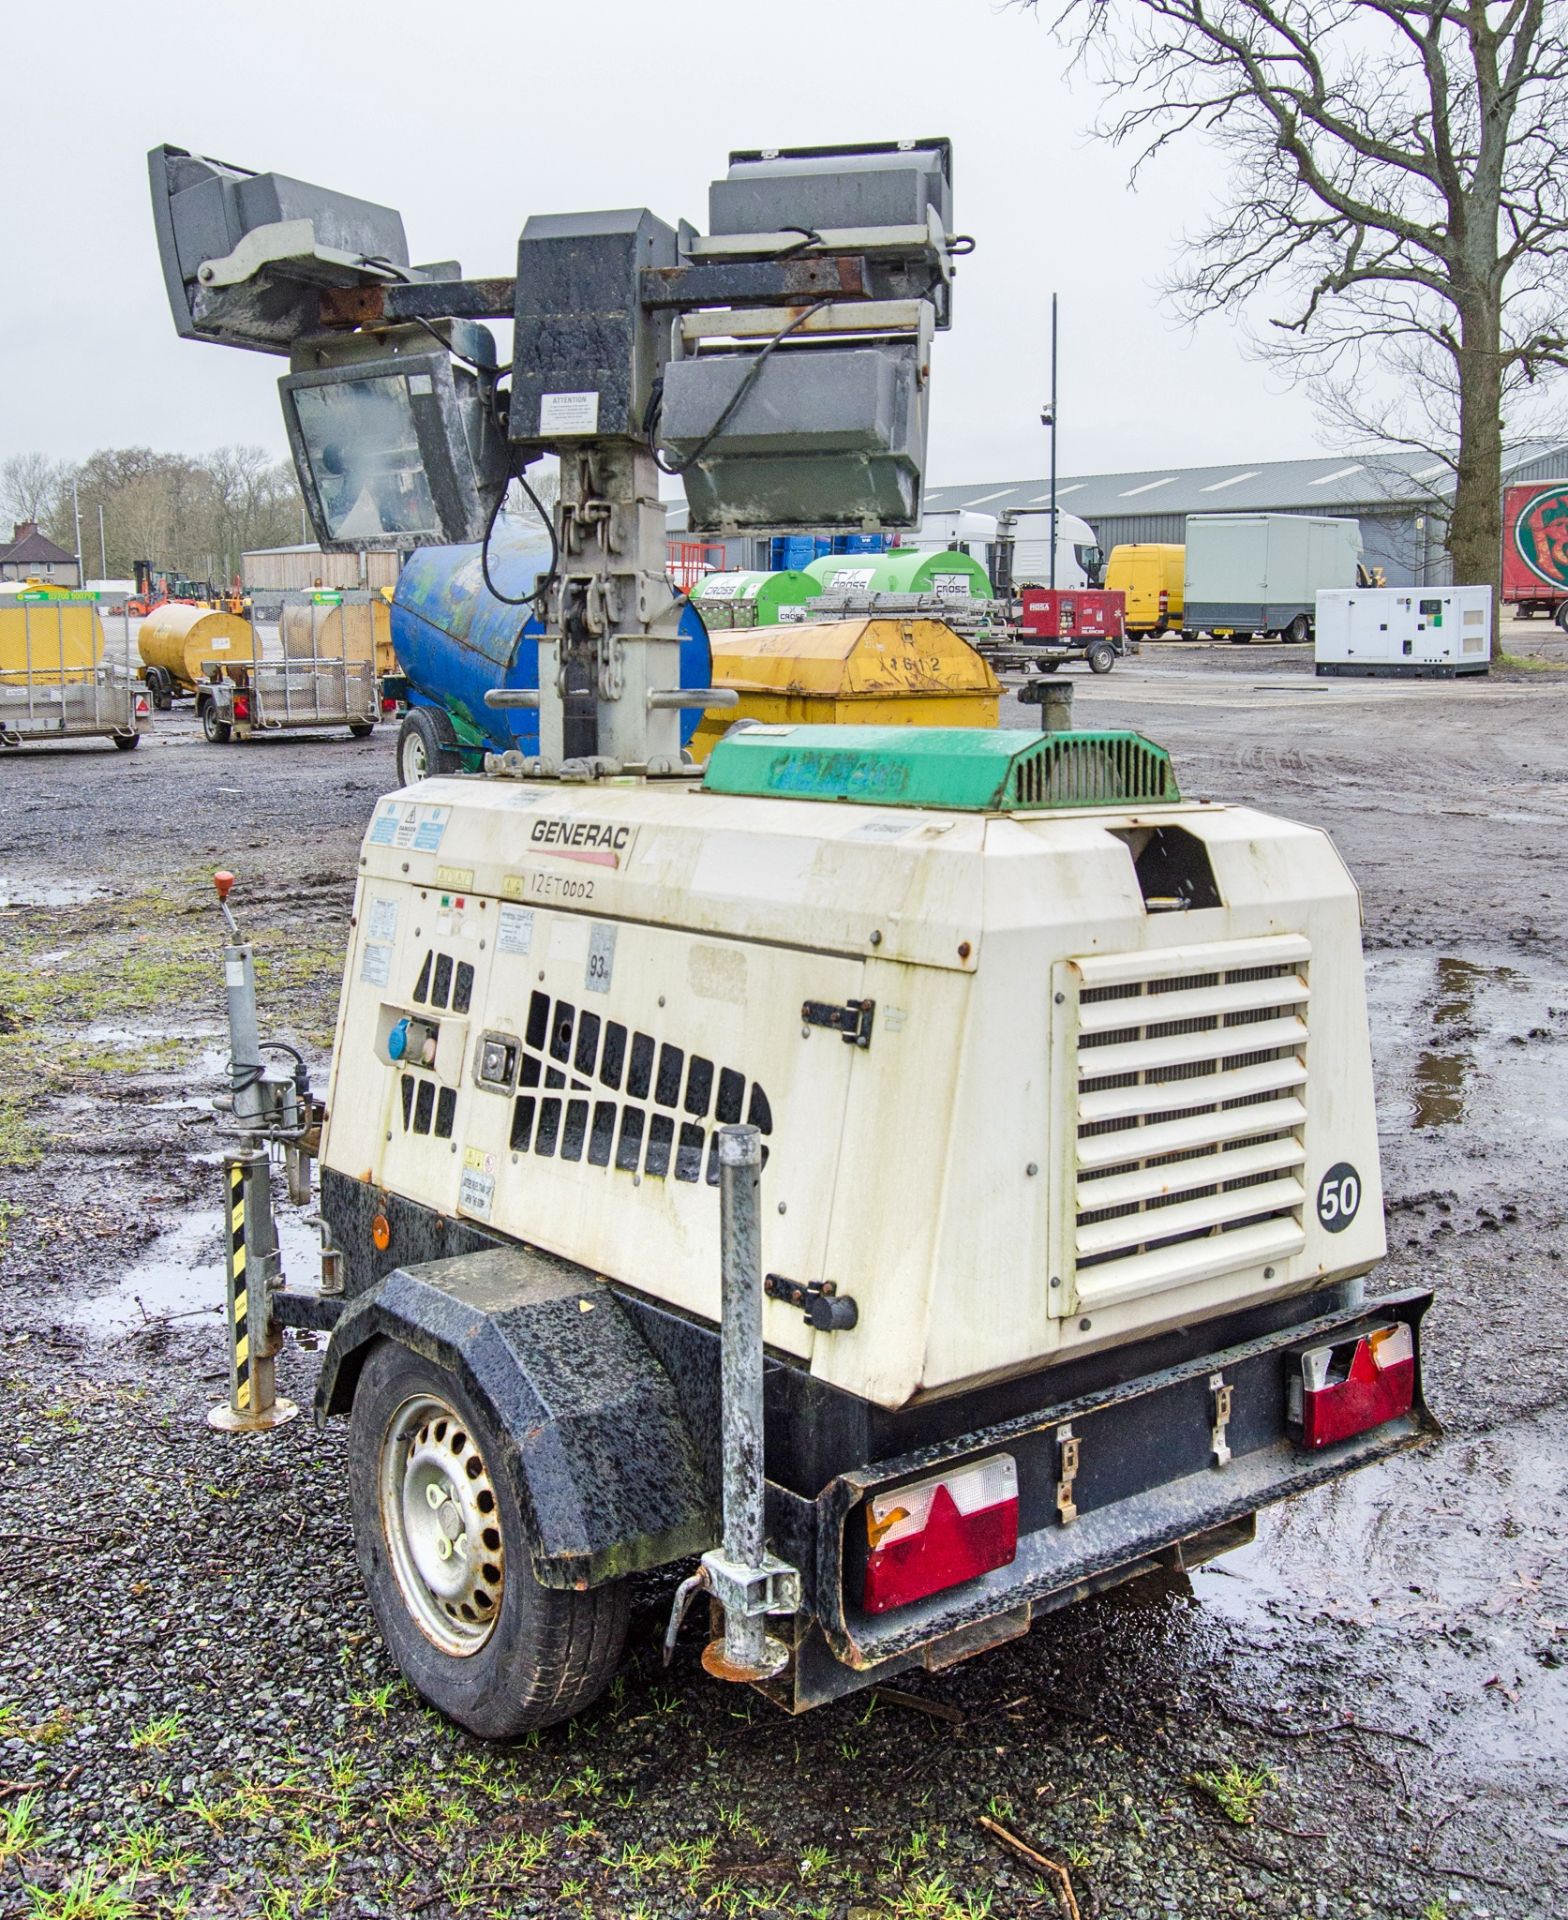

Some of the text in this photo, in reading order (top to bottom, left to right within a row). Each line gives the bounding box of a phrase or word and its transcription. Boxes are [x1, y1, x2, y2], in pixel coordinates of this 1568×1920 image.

[704, 586, 736, 594] CROSS
[531, 820, 629, 850] GENERAC
[1320, 1176, 1358, 1221] 50
